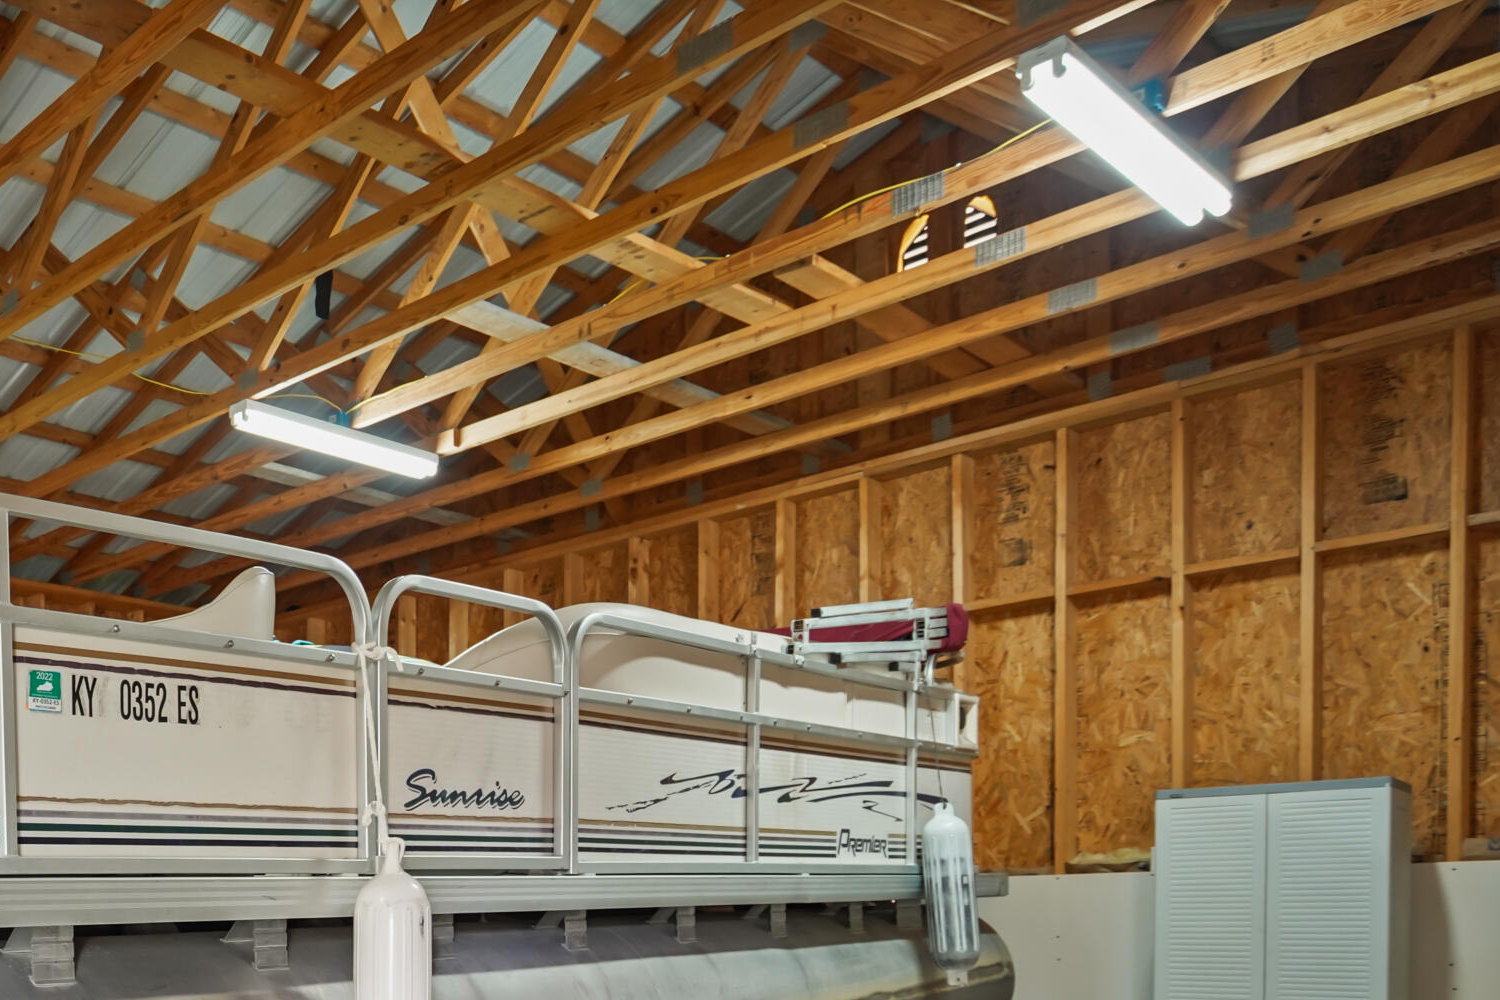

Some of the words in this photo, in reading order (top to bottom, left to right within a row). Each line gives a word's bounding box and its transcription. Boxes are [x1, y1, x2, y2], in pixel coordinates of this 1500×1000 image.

[36, 671, 53, 681] 2022
[72, 674, 97, 717] KY
[120, 679, 168, 723] 0352
[177, 685, 199, 725] ES
[403, 768, 525, 811] Sunrise
